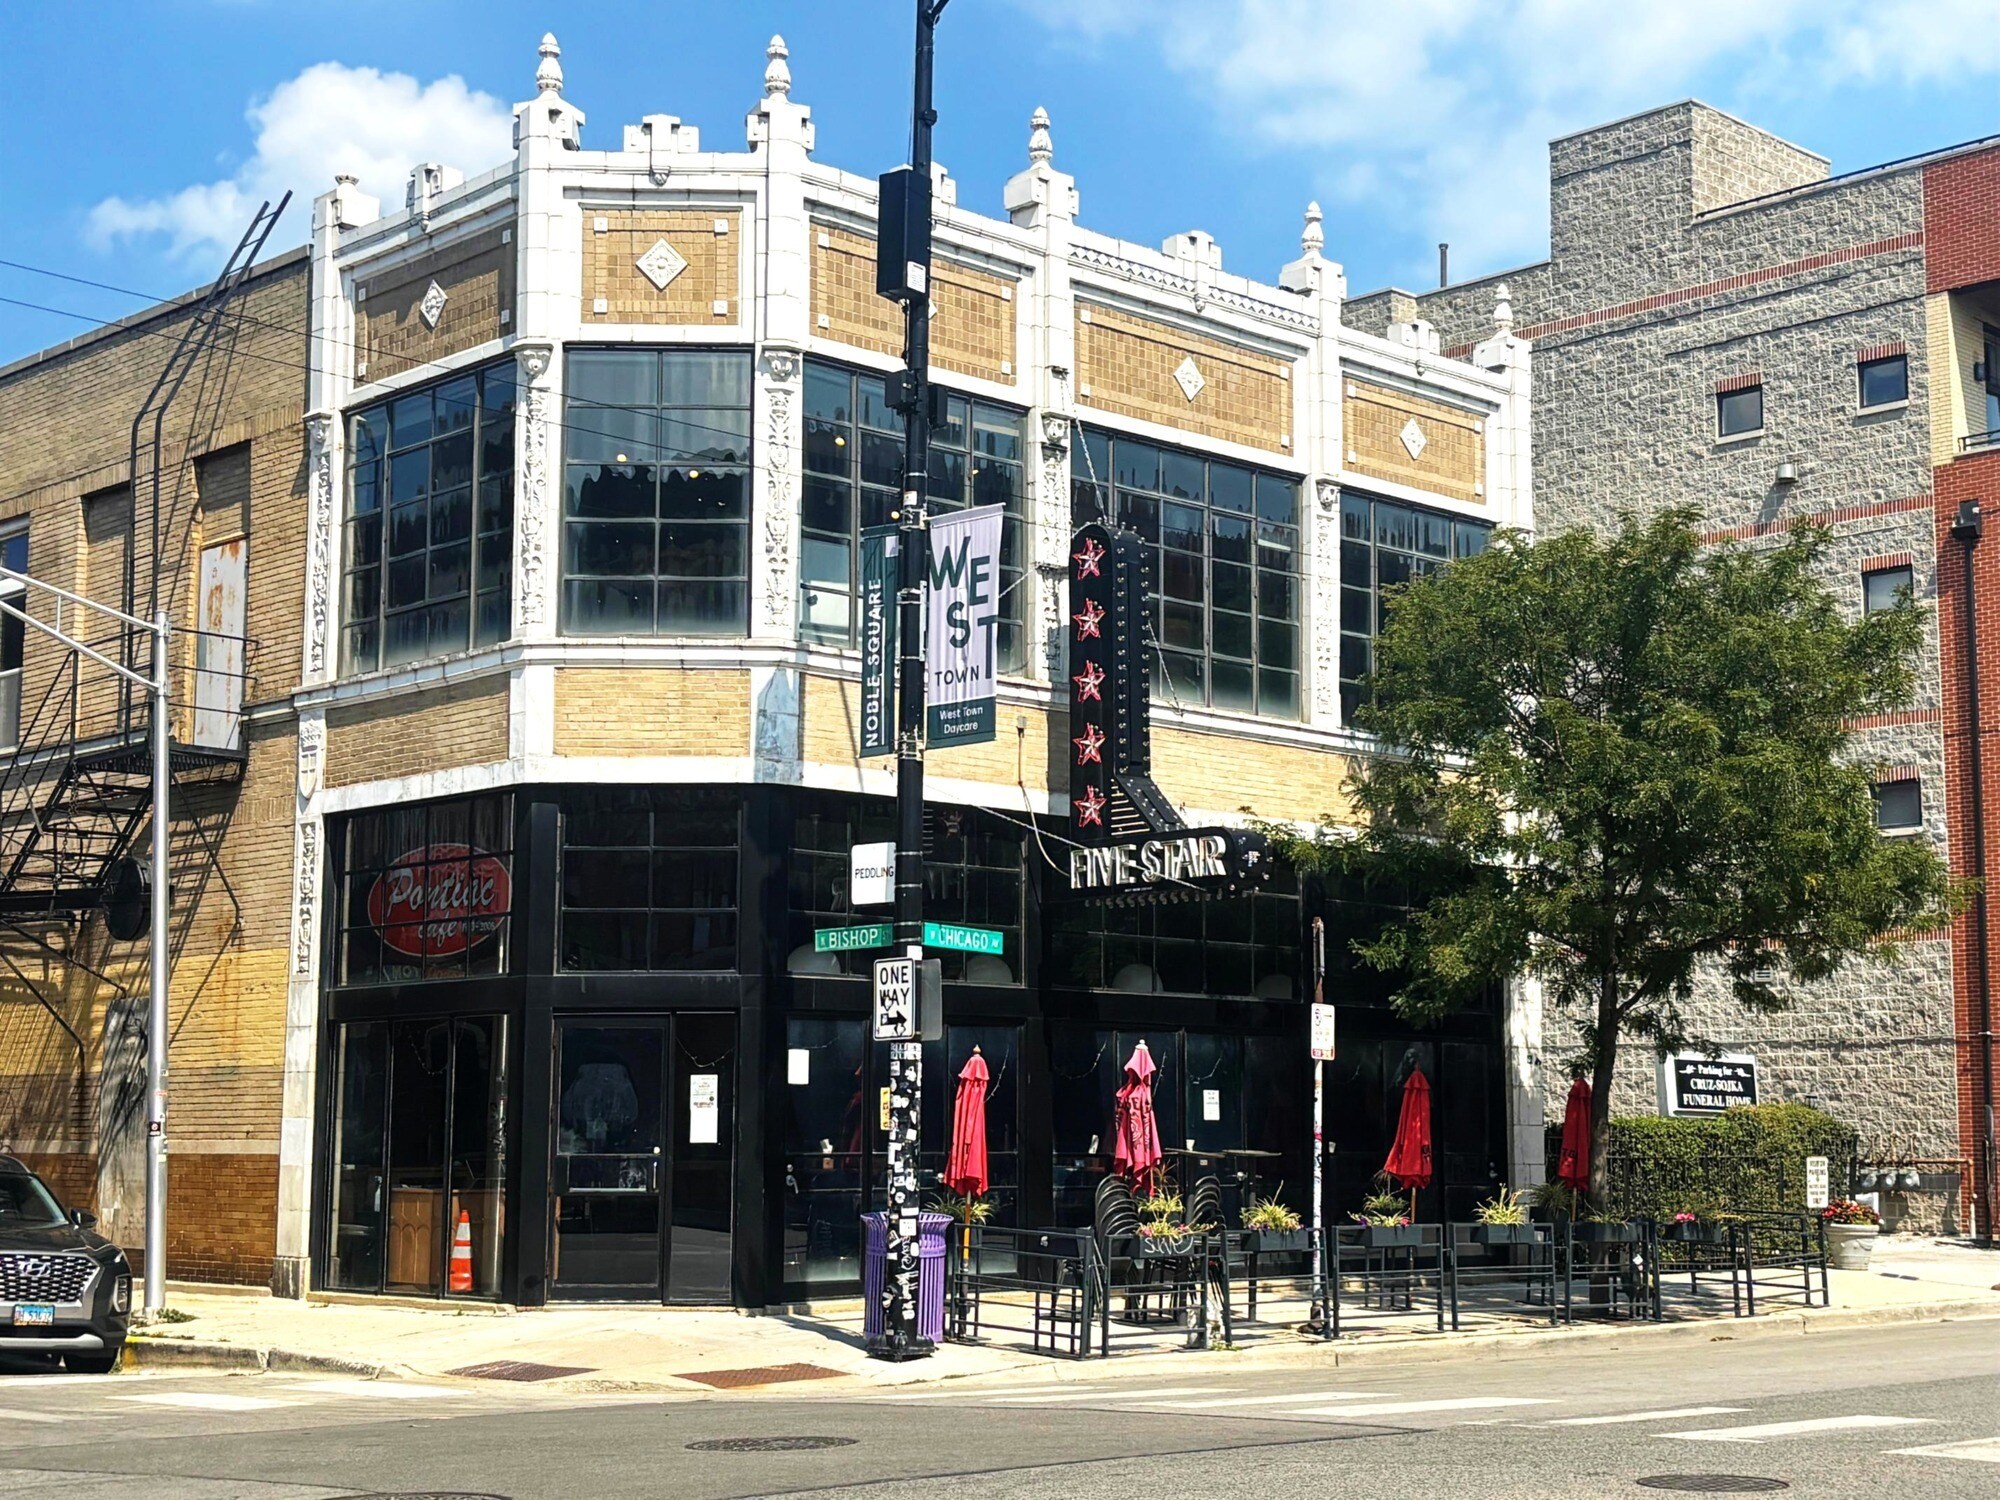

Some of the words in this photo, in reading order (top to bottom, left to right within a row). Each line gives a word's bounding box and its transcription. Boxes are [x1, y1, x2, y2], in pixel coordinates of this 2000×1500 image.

[867, 578, 882, 666] SQUARE
[934, 665, 980, 687] TOWN
[866, 674, 881, 747] NOBLE
[939, 709, 961, 721] West
[962, 706, 984, 718] Town
[943, 721, 979, 735] Daycare
[854, 865, 895, 879] PEDDLING
[1070, 843, 1137, 890] FIVE
[1140, 836, 1227, 884] STAR
[386, 868, 496, 918] Pontiac
[828, 928, 879, 949] BISHOP
[938, 927, 989, 950] CHICAGO
[879, 965, 909, 985] ONE
[879, 987, 910, 1007] WAY
[1697, 1064, 1723, 1078] Parking
[1690, 1078, 1744, 1093] CRUZ-SOJKA
[1683, 1093, 1726, 1107] FUNERAL
[1726, 1095, 1752, 1107] HOME
